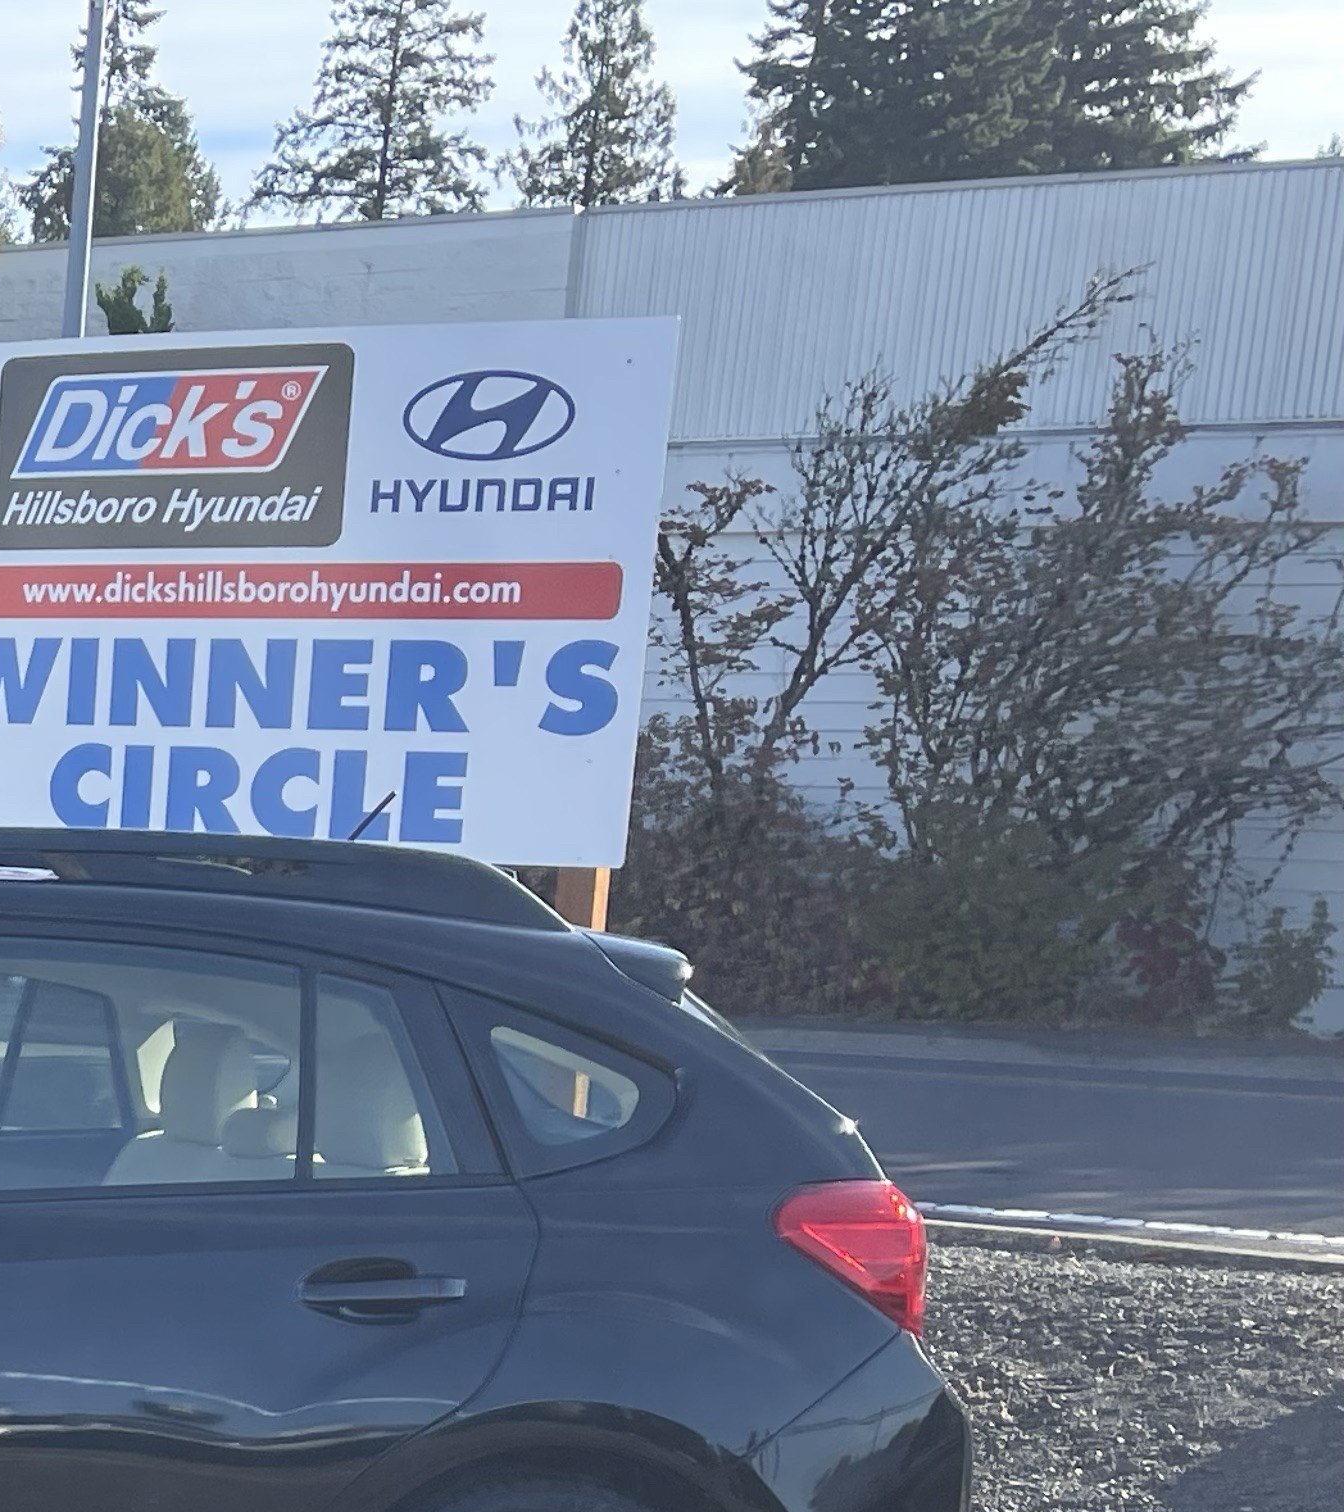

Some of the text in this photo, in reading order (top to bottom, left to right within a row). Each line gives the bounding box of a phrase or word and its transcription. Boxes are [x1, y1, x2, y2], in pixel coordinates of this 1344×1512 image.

[2, 485, 324, 533] Hillsboro Hyundai
[370, 476, 596, 514] HYUNDAI
[22, 569, 522, 613] www.dickshillsborohyundai.com
[49, 741, 469, 844] CIRCLE
